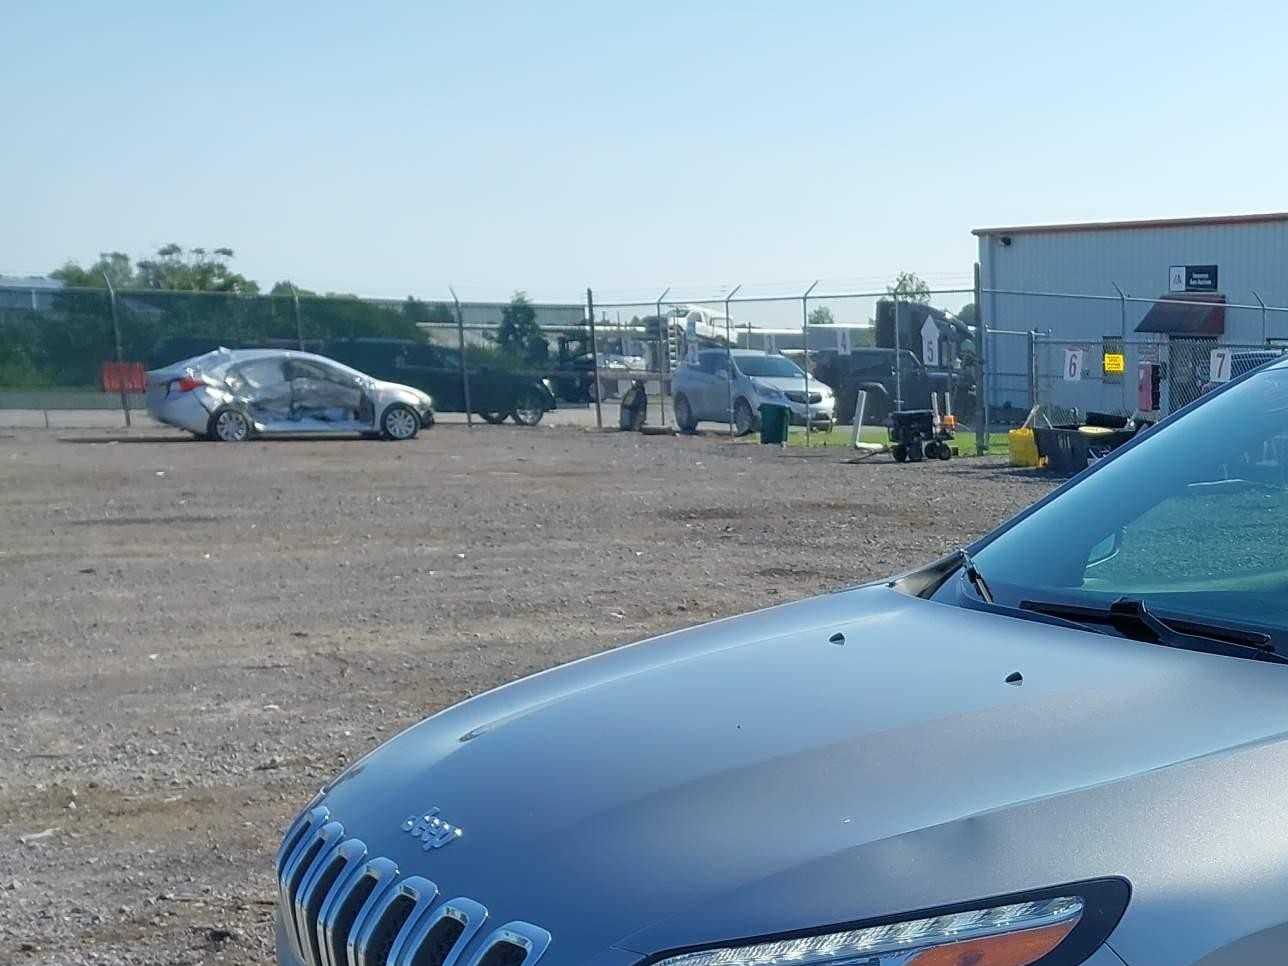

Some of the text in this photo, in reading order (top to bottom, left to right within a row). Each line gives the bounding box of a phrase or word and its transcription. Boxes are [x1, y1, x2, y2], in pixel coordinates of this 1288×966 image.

[926, 340, 934, 362] 5
[1068, 353, 1078, 378] 6
[1216, 352, 1226, 378] 7
[400, 805, 463, 853] Jeep
